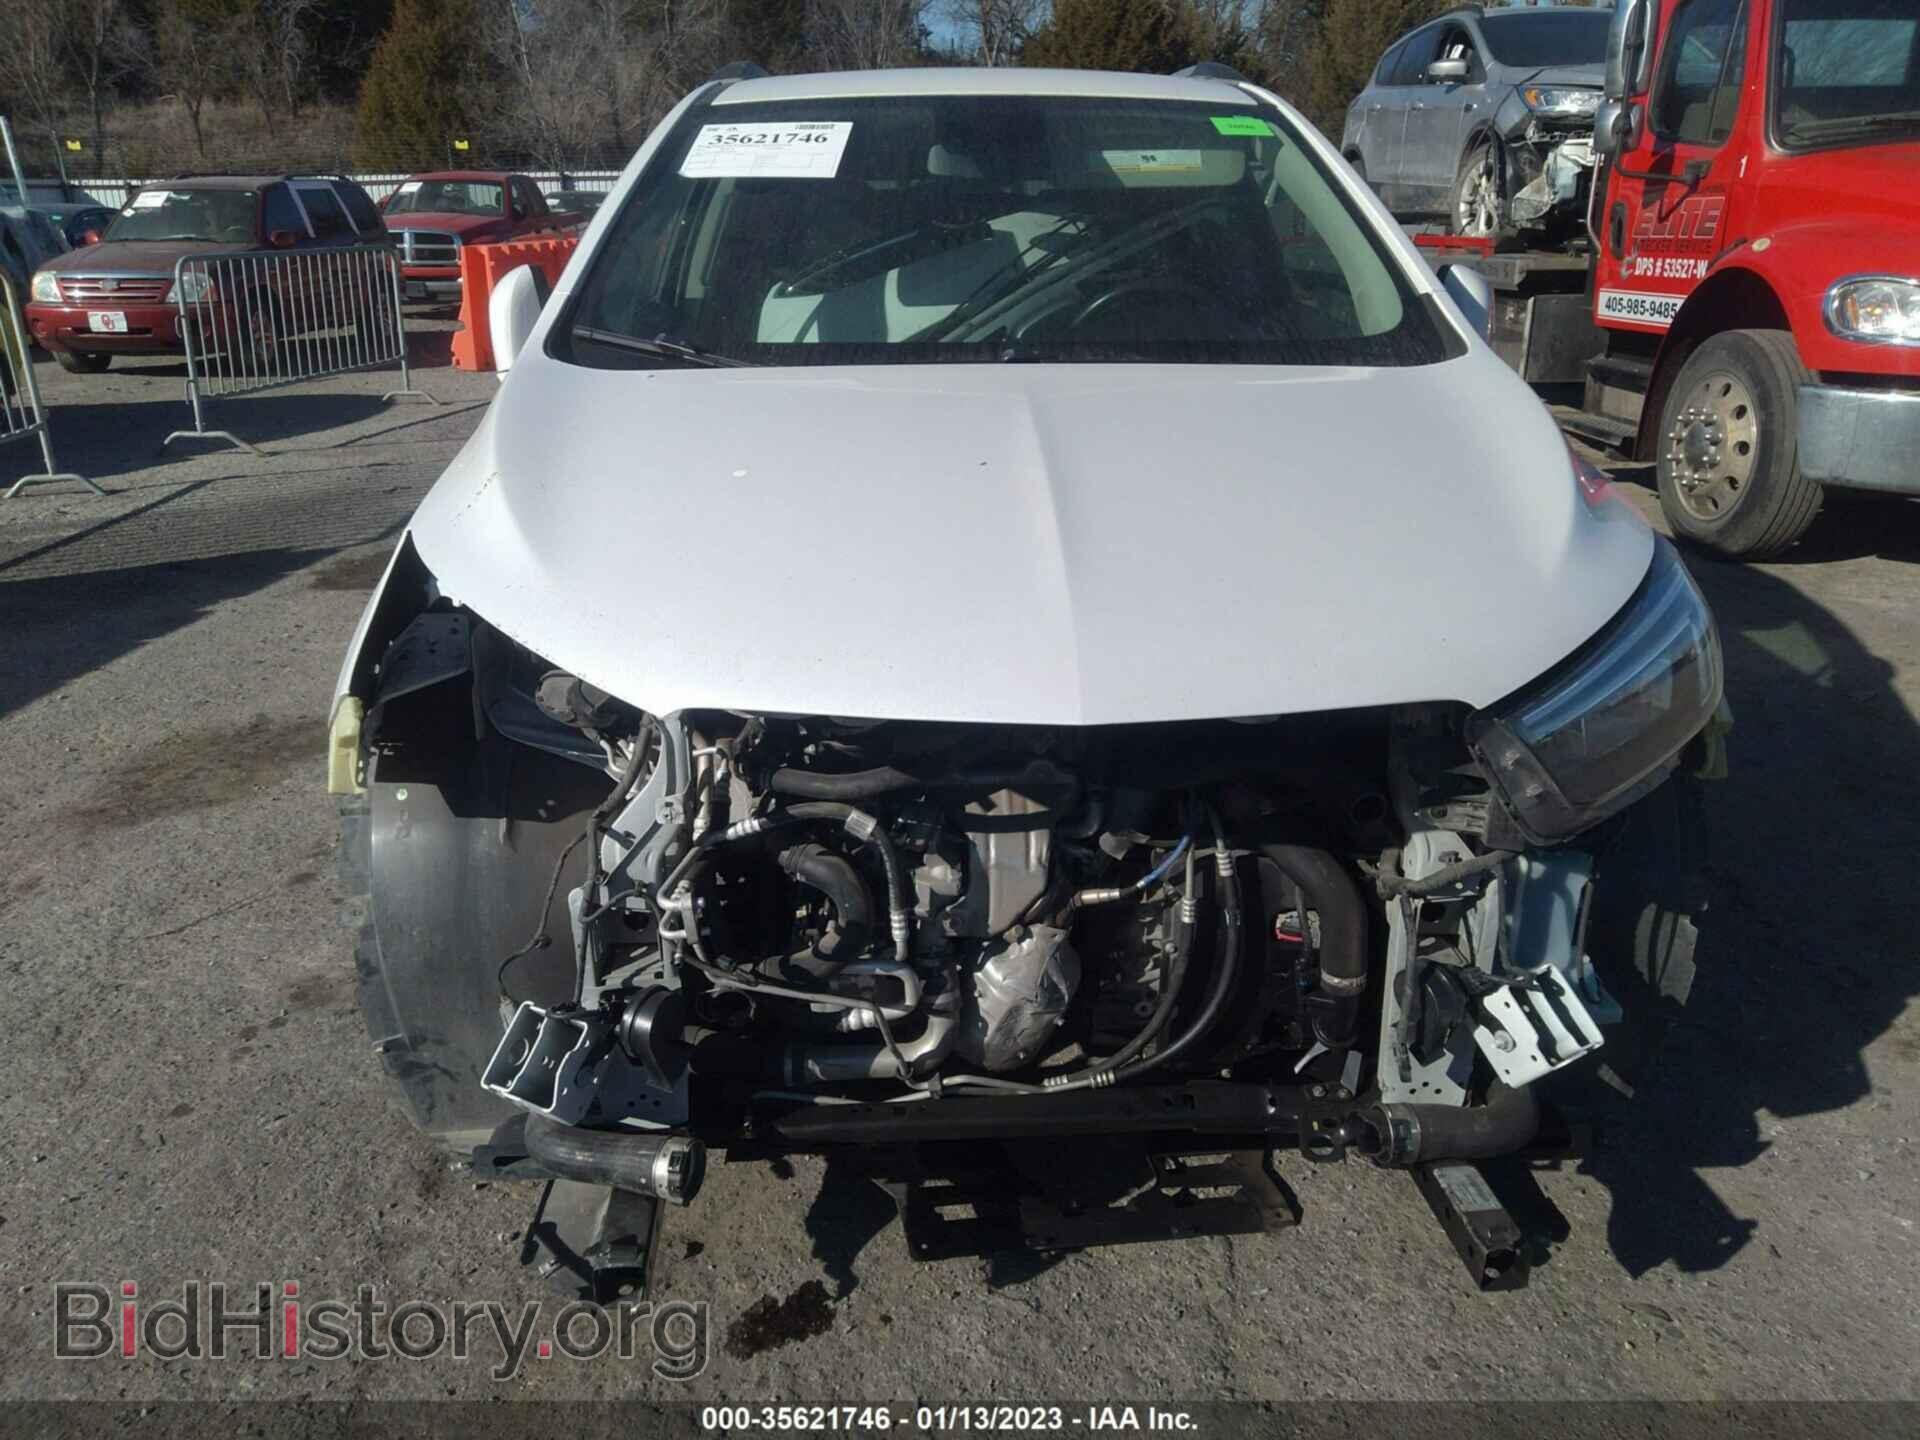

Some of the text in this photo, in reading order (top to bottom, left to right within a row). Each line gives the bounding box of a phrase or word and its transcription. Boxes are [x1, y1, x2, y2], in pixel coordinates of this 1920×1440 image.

[708, 133, 828, 145] 35621746
[1738, 155, 1749, 179] 1
[1632, 196, 1725, 239] ELITE
[1634, 257, 1655, 276] DPS
[1663, 258, 1709, 279] 53527-W
[1605, 296, 1678, 320] 405-985-9485
